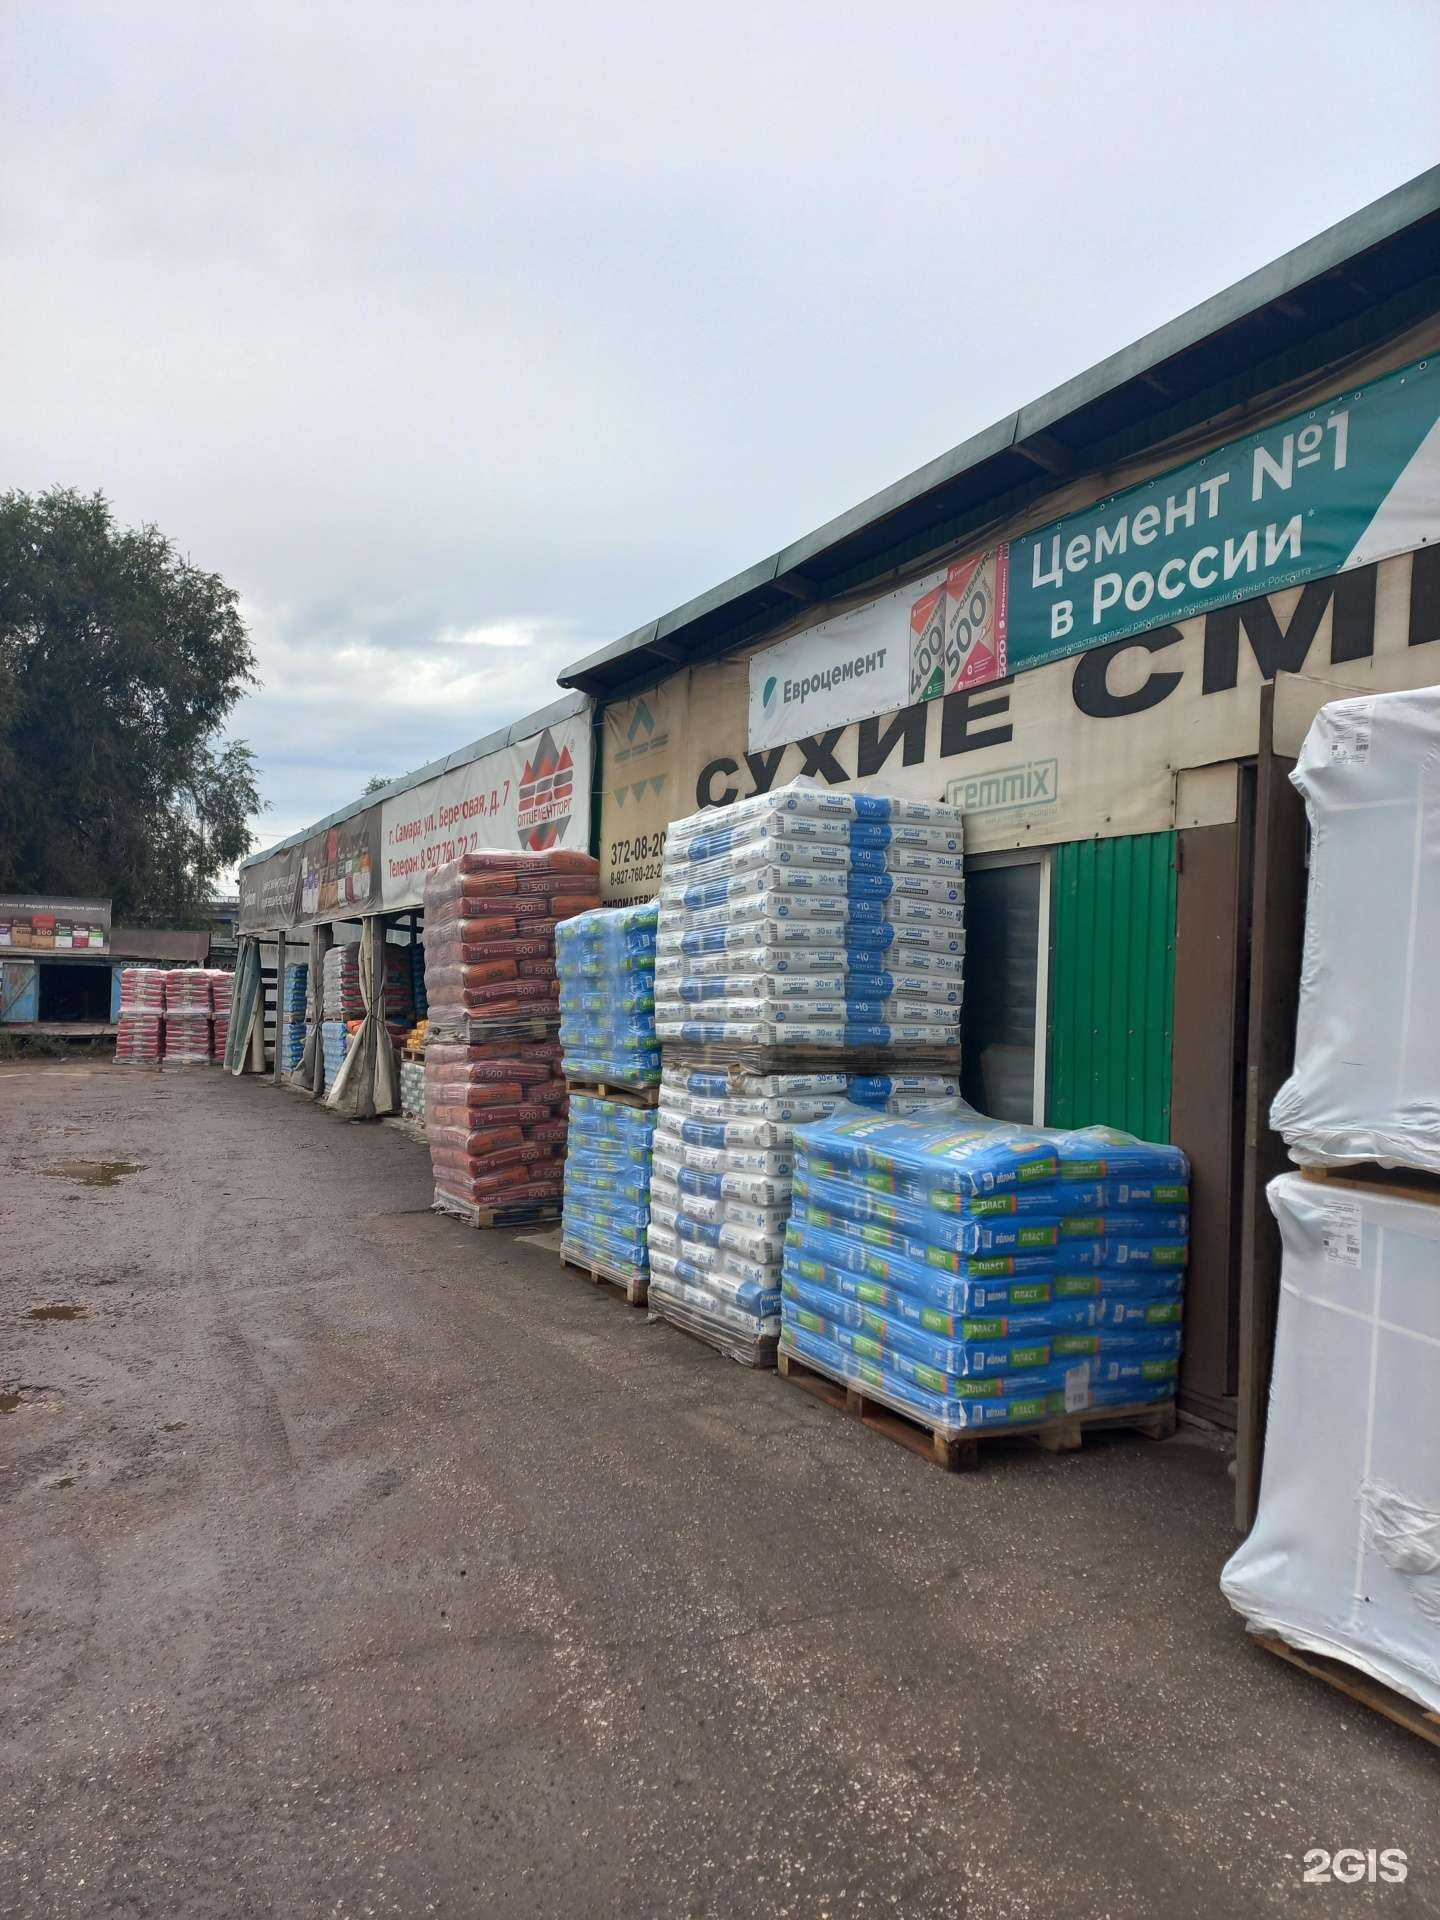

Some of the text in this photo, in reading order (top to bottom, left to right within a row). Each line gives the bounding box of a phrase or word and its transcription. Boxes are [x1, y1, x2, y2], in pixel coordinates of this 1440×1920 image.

[1032, 410, 1350, 589] Цемент №1
[945, 591, 987, 678] 500
[1051, 599, 1074, 640] в
[783, 648, 887, 703] Евроцемент
[910, 626, 942, 695] 400
[696, 675, 1014, 808] СУХИЕ
[953, 761, 1050, 808] remmix
[395, 820, 423, 844] Самара,
[424, 817, 437, 840] ул.
[503, 780, 511, 805] 7
[388, 855, 420, 878] Телефон:
[421, 848, 426, 870] 8
[427, 845, 440, 868] 927
[611, 831, 667, 866] 372-08-20
[515, 903, 533, 912] 500
[516, 946, 534, 955] 500
[520, 1111, 537, 1120] 500
[521, 1151, 539, 1160] 500
[1022, 1165, 1044, 1177] ПЛАСТ
[1022, 1233, 1044, 1242] ПЛАСТ
